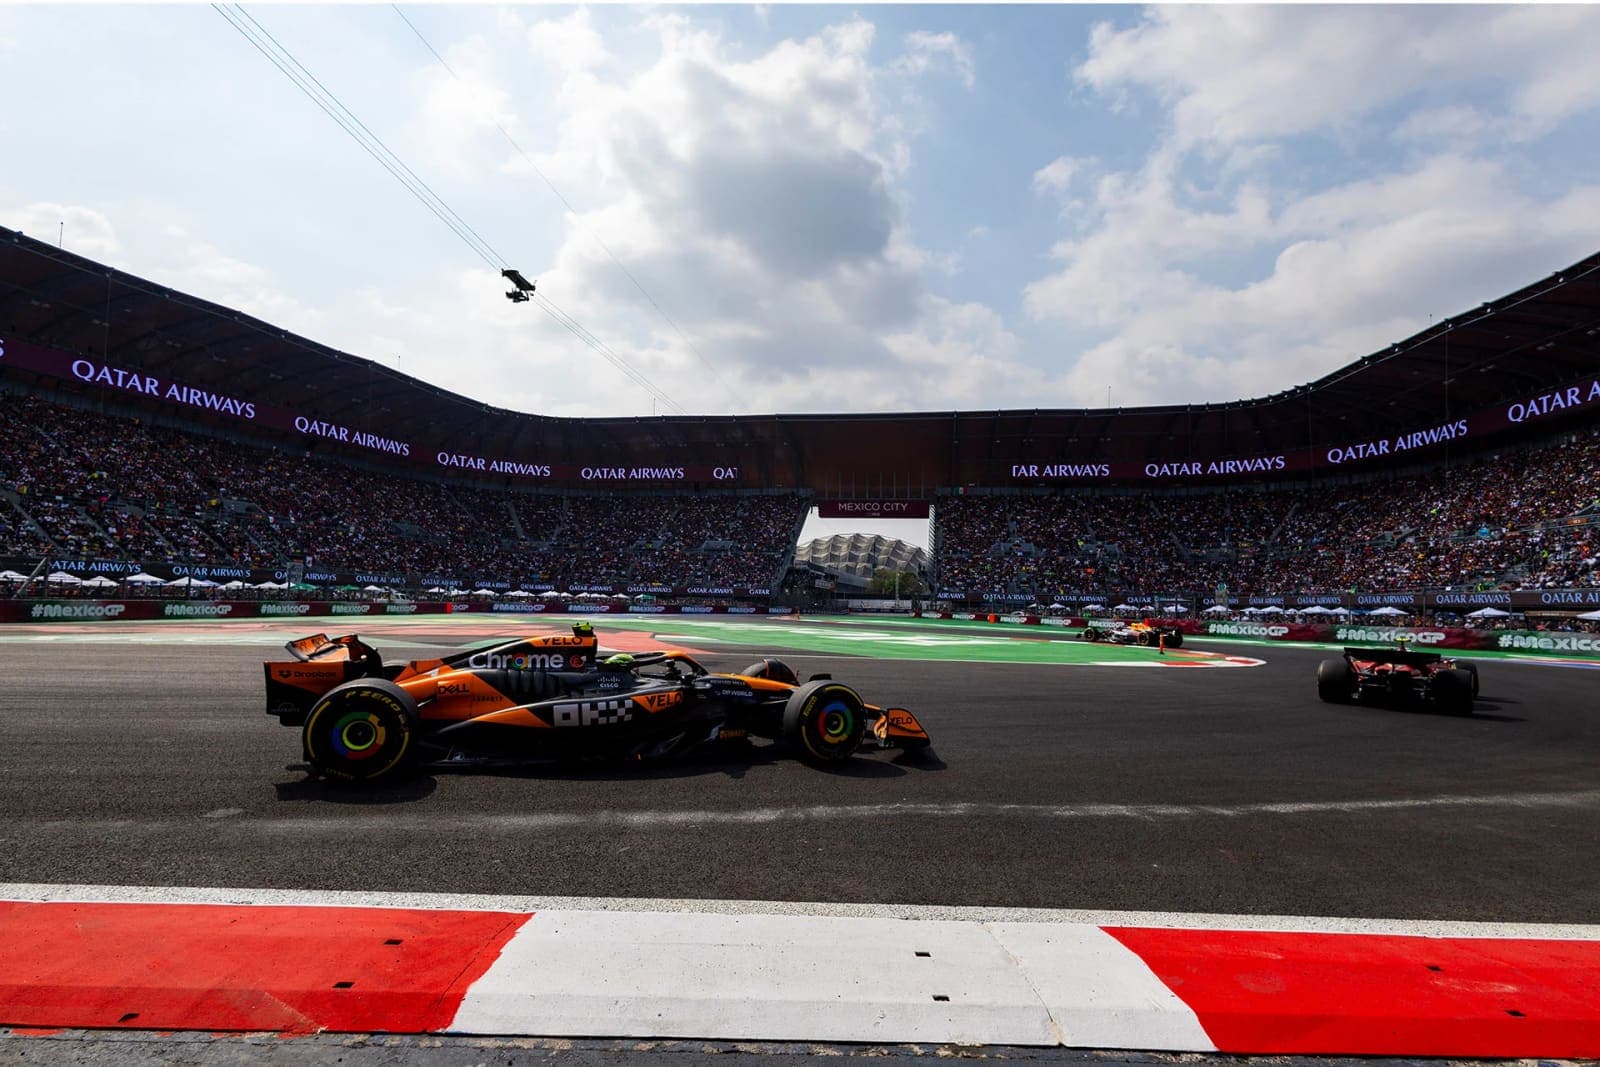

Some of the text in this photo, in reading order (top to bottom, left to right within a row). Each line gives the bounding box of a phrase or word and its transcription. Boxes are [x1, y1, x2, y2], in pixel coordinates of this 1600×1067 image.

[72, 360, 256, 419] QATAR AIRWAYS
[1507, 387, 1582, 423] QATAR
[295, 416, 410, 457] QATAR AIRWAYS
[1327, 419, 1468, 463] QATAR AIRWAYS
[437, 452, 551, 477] QATAR AIRWAYS
[1042, 464, 1110, 477] AIRWAYS
[1145, 455, 1286, 478] QATAR AIRWAYS
[581, 467, 685, 480] QATAR AIRWAYS
[838, 503, 909, 512] MEXICO CITY
[49, 560, 86, 571] ATAR
[1357, 595, 1415, 604] QATAR AIRWAYS
[1436, 593, 1511, 604] QATAR AIRWAYS
[1541, 592, 1583, 604] QATAR
[31, 603, 126, 617] #MexicoGP
[164, 604, 233, 616] #MexicoGP
[261, 604, 310, 614] #MexicoGP
[1208, 623, 1289, 637] #MexicoGP
[1336, 628, 1446, 643] #MexicoGP
[541, 637, 584, 646] VELO
[469, 653, 565, 671] Chrome
[437, 684, 470, 695] DELL
[647, 693, 683, 707] VELO
